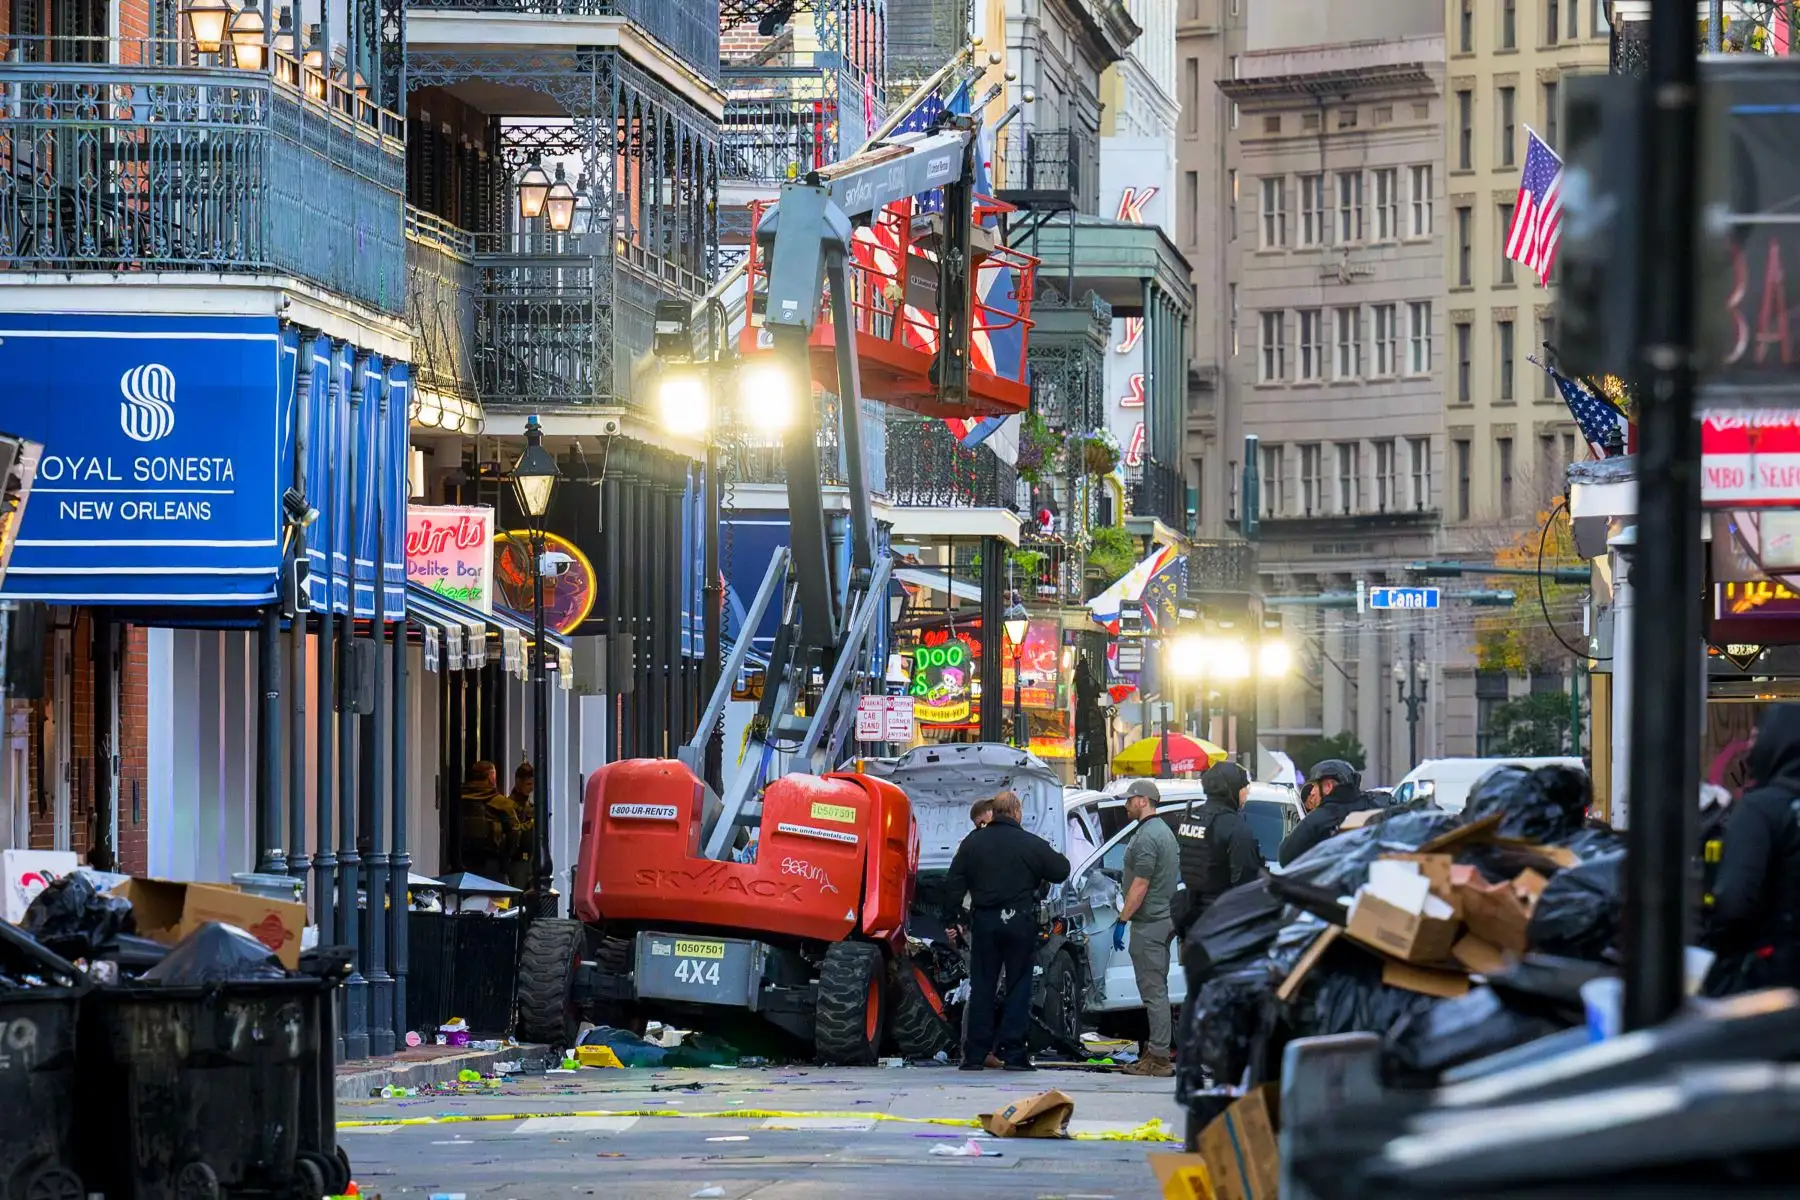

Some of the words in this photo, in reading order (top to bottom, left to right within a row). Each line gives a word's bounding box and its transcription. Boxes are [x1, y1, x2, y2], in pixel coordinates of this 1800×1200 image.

[33, 456, 123, 481] OYAL
[133, 456, 234, 482] SONESTA
[60, 501, 113, 520] NEW
[120, 501, 212, 521] ORLEANS
[407, 560, 449, 576] Delite
[457, 560, 482, 577] Bar
[1388, 590, 1427, 608] Canal
[860, 721, 880, 729] STAND
[779, 825, 857, 843] www.unitedrentals.com
[636, 863, 803, 902] SKYJACK
[676, 943, 723, 955] 10507501
[674, 959, 720, 986] 4X4
